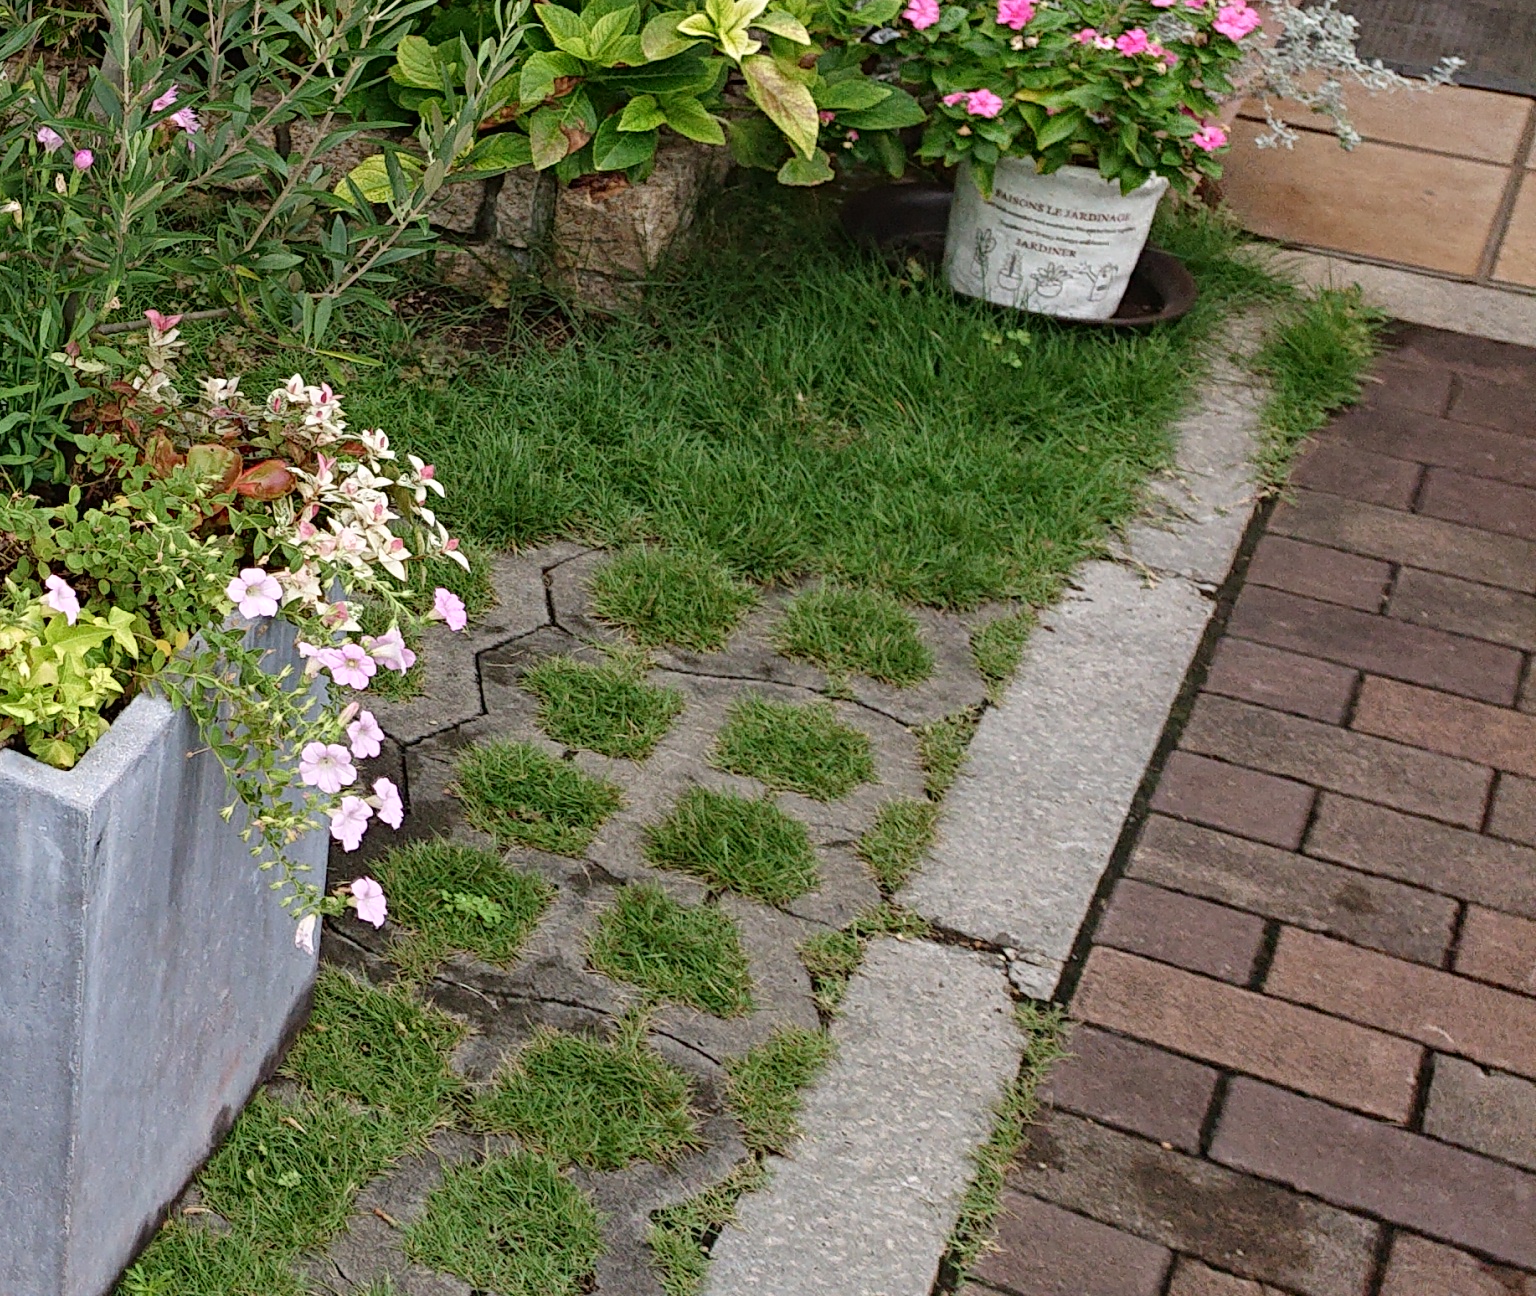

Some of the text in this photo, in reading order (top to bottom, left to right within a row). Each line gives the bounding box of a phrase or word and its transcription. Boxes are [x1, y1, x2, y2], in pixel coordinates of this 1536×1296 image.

[1046, 205, 1063, 217] LE
[1064, 209, 1132, 223] JARDINAGE
[1015, 238, 1077, 258] JARDINER
